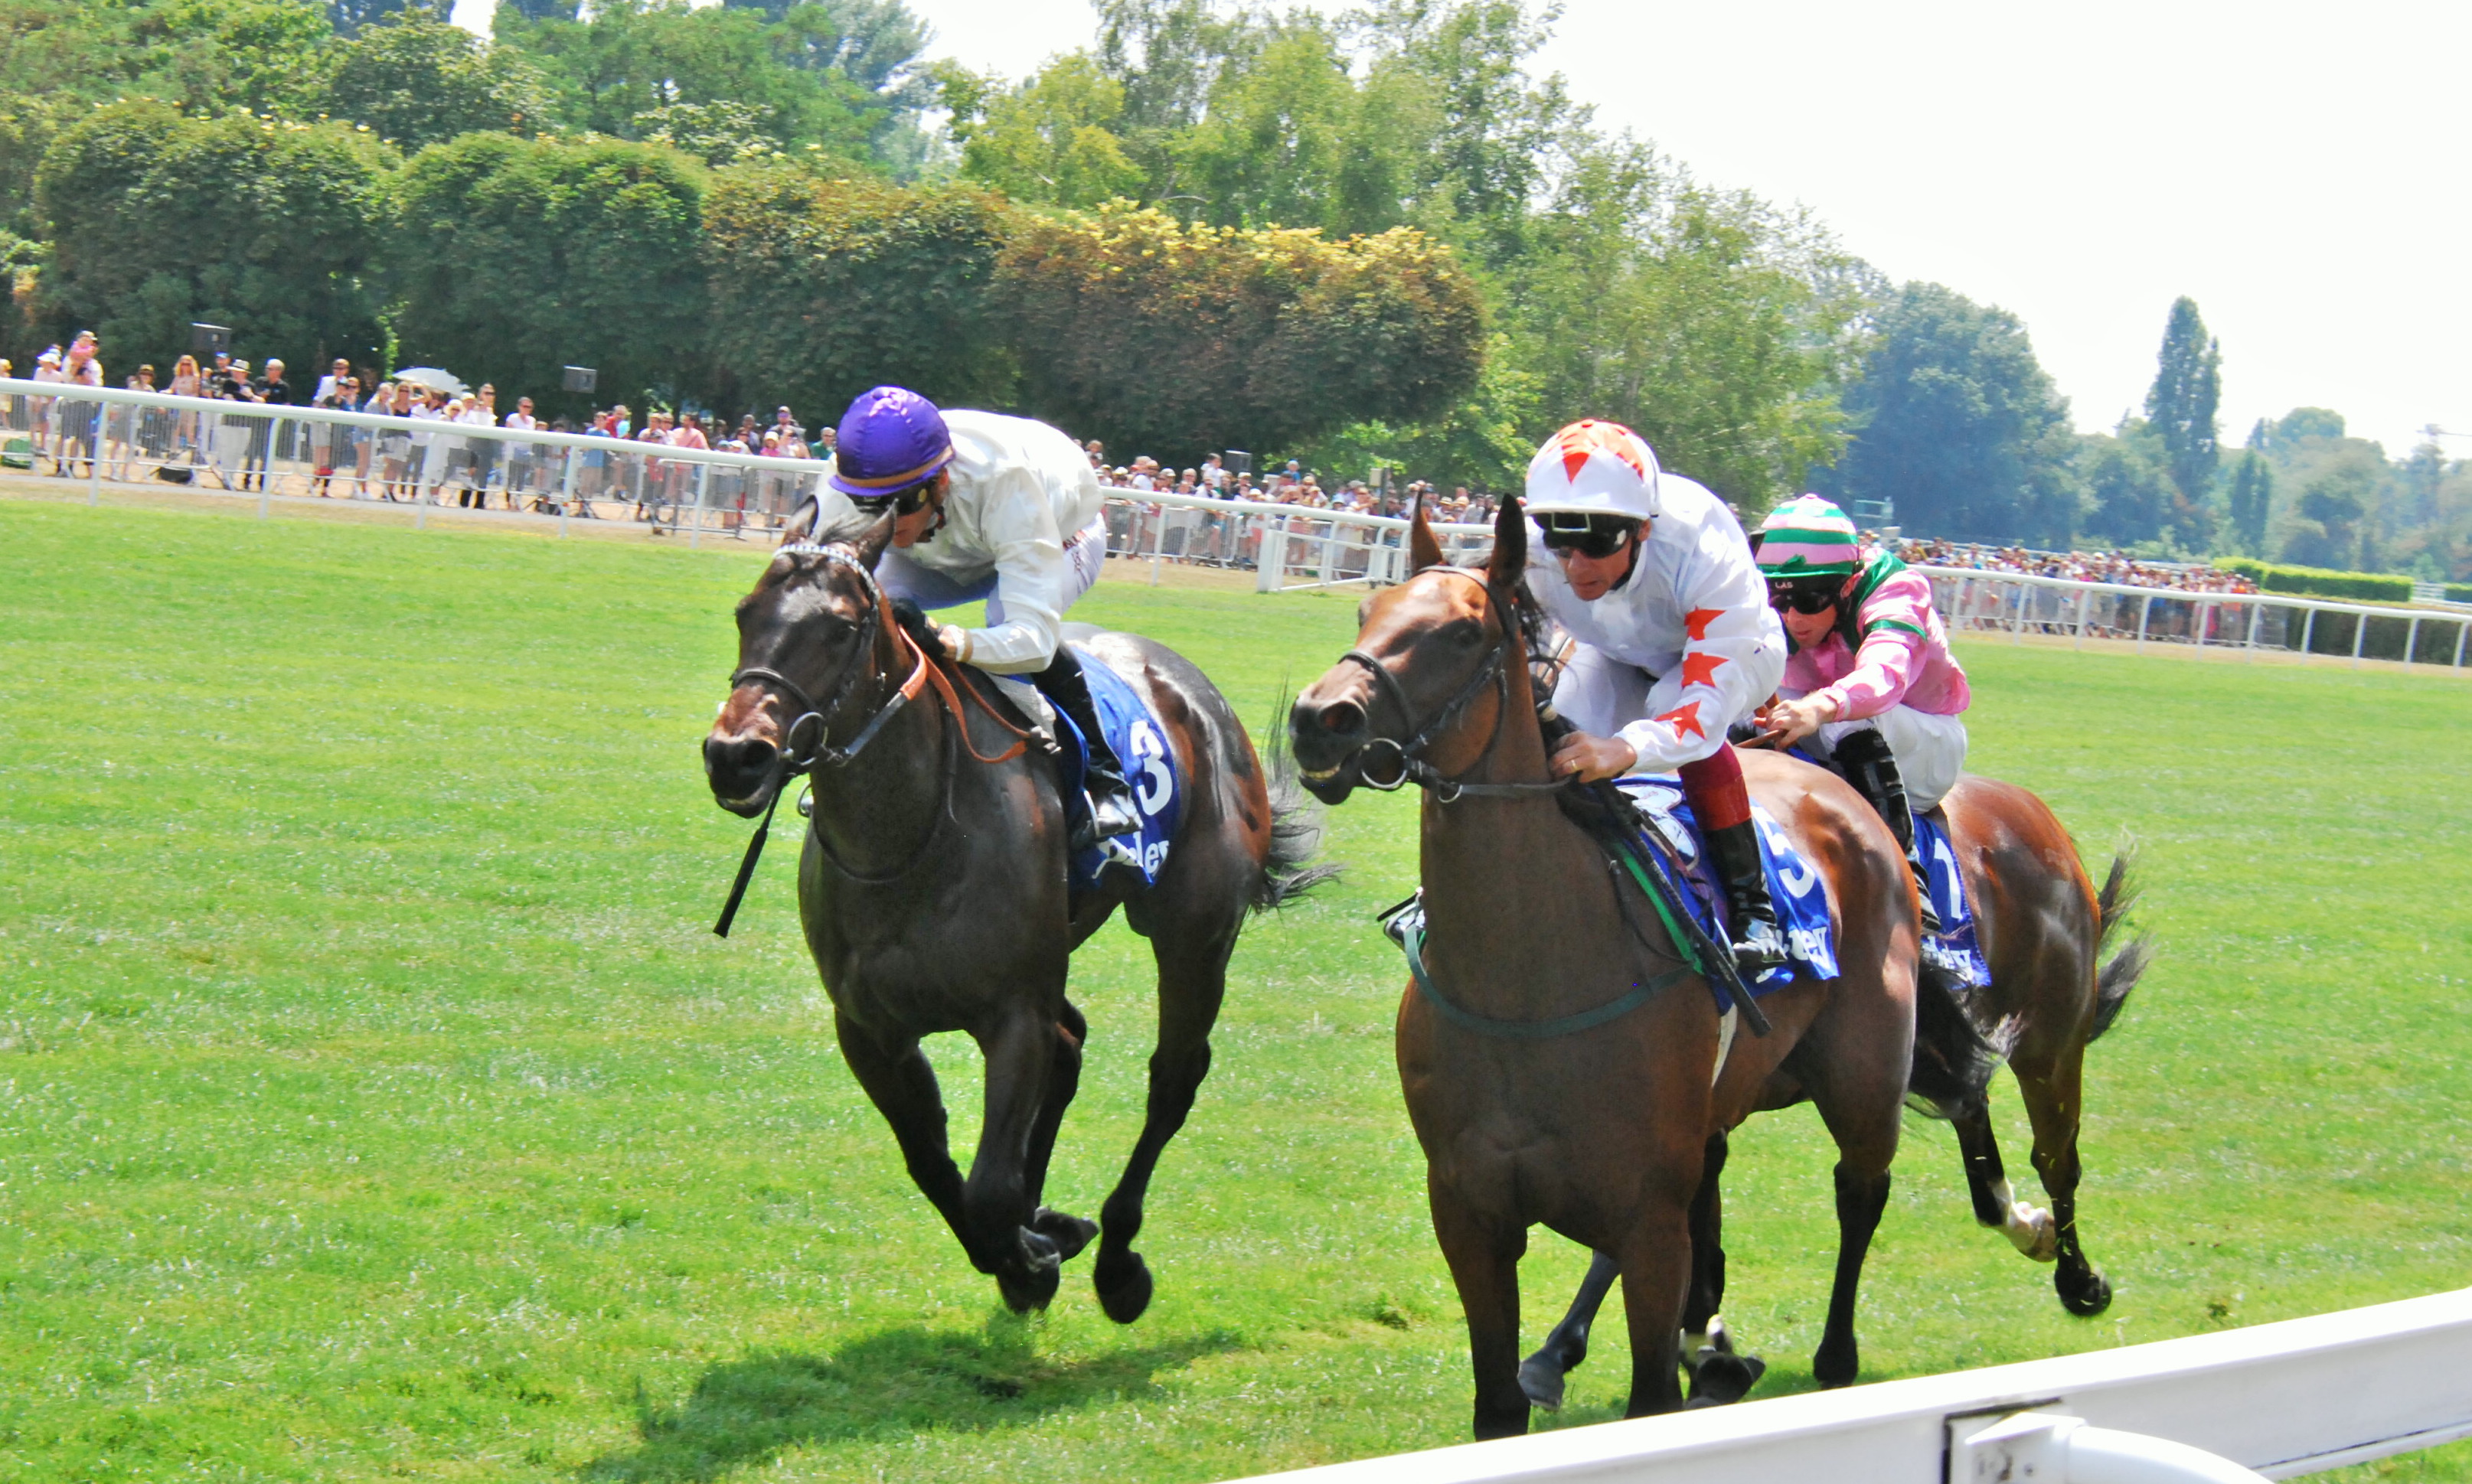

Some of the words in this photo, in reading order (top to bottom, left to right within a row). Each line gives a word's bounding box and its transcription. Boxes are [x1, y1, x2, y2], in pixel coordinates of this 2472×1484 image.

[1130, 720, 1173, 816] 3
[1749, 806, 1815, 899] 5
[1934, 838, 1963, 919] 1
